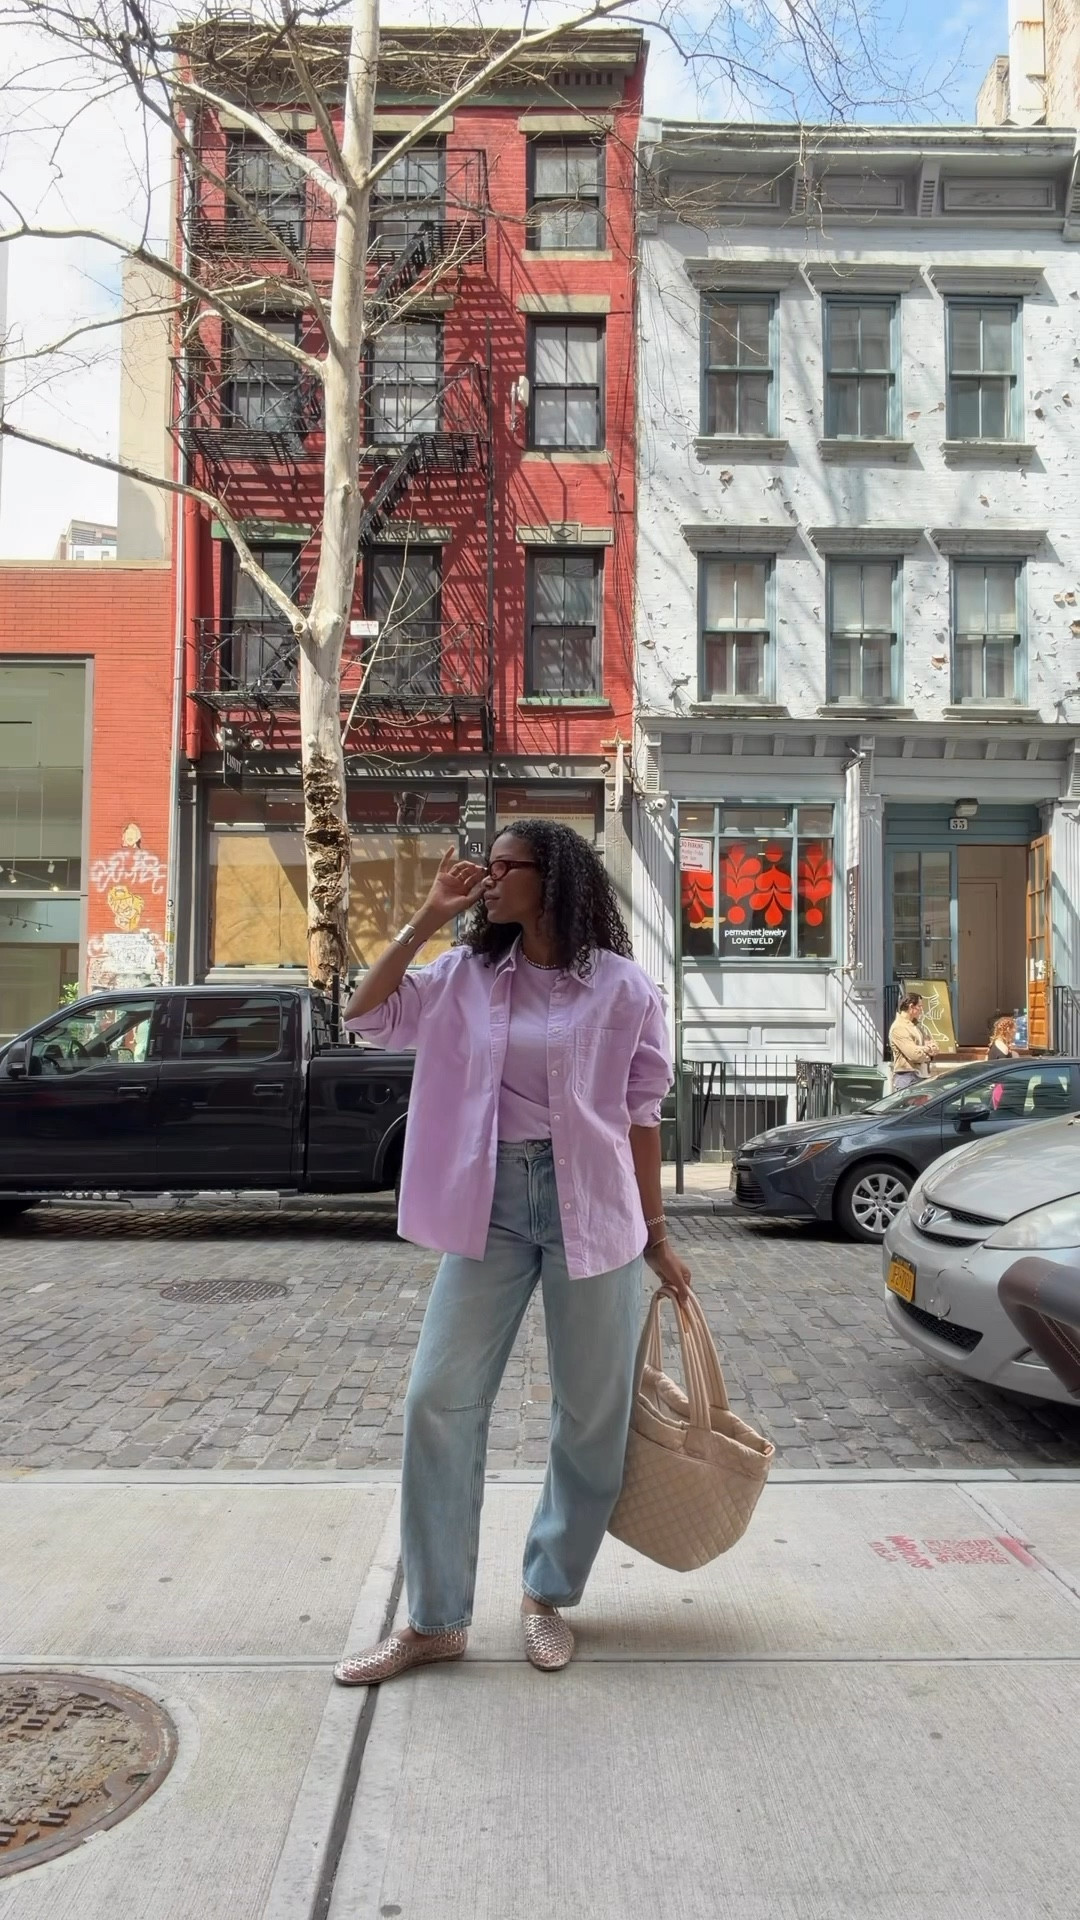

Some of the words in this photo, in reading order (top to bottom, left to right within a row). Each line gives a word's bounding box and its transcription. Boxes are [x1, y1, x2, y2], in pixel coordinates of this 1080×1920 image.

[471, 843, 482, 853] 51
[724, 928, 762, 937] permanent
[762, 928, 787, 938] jewelry
[731, 937, 774, 945] LOVEWELD
